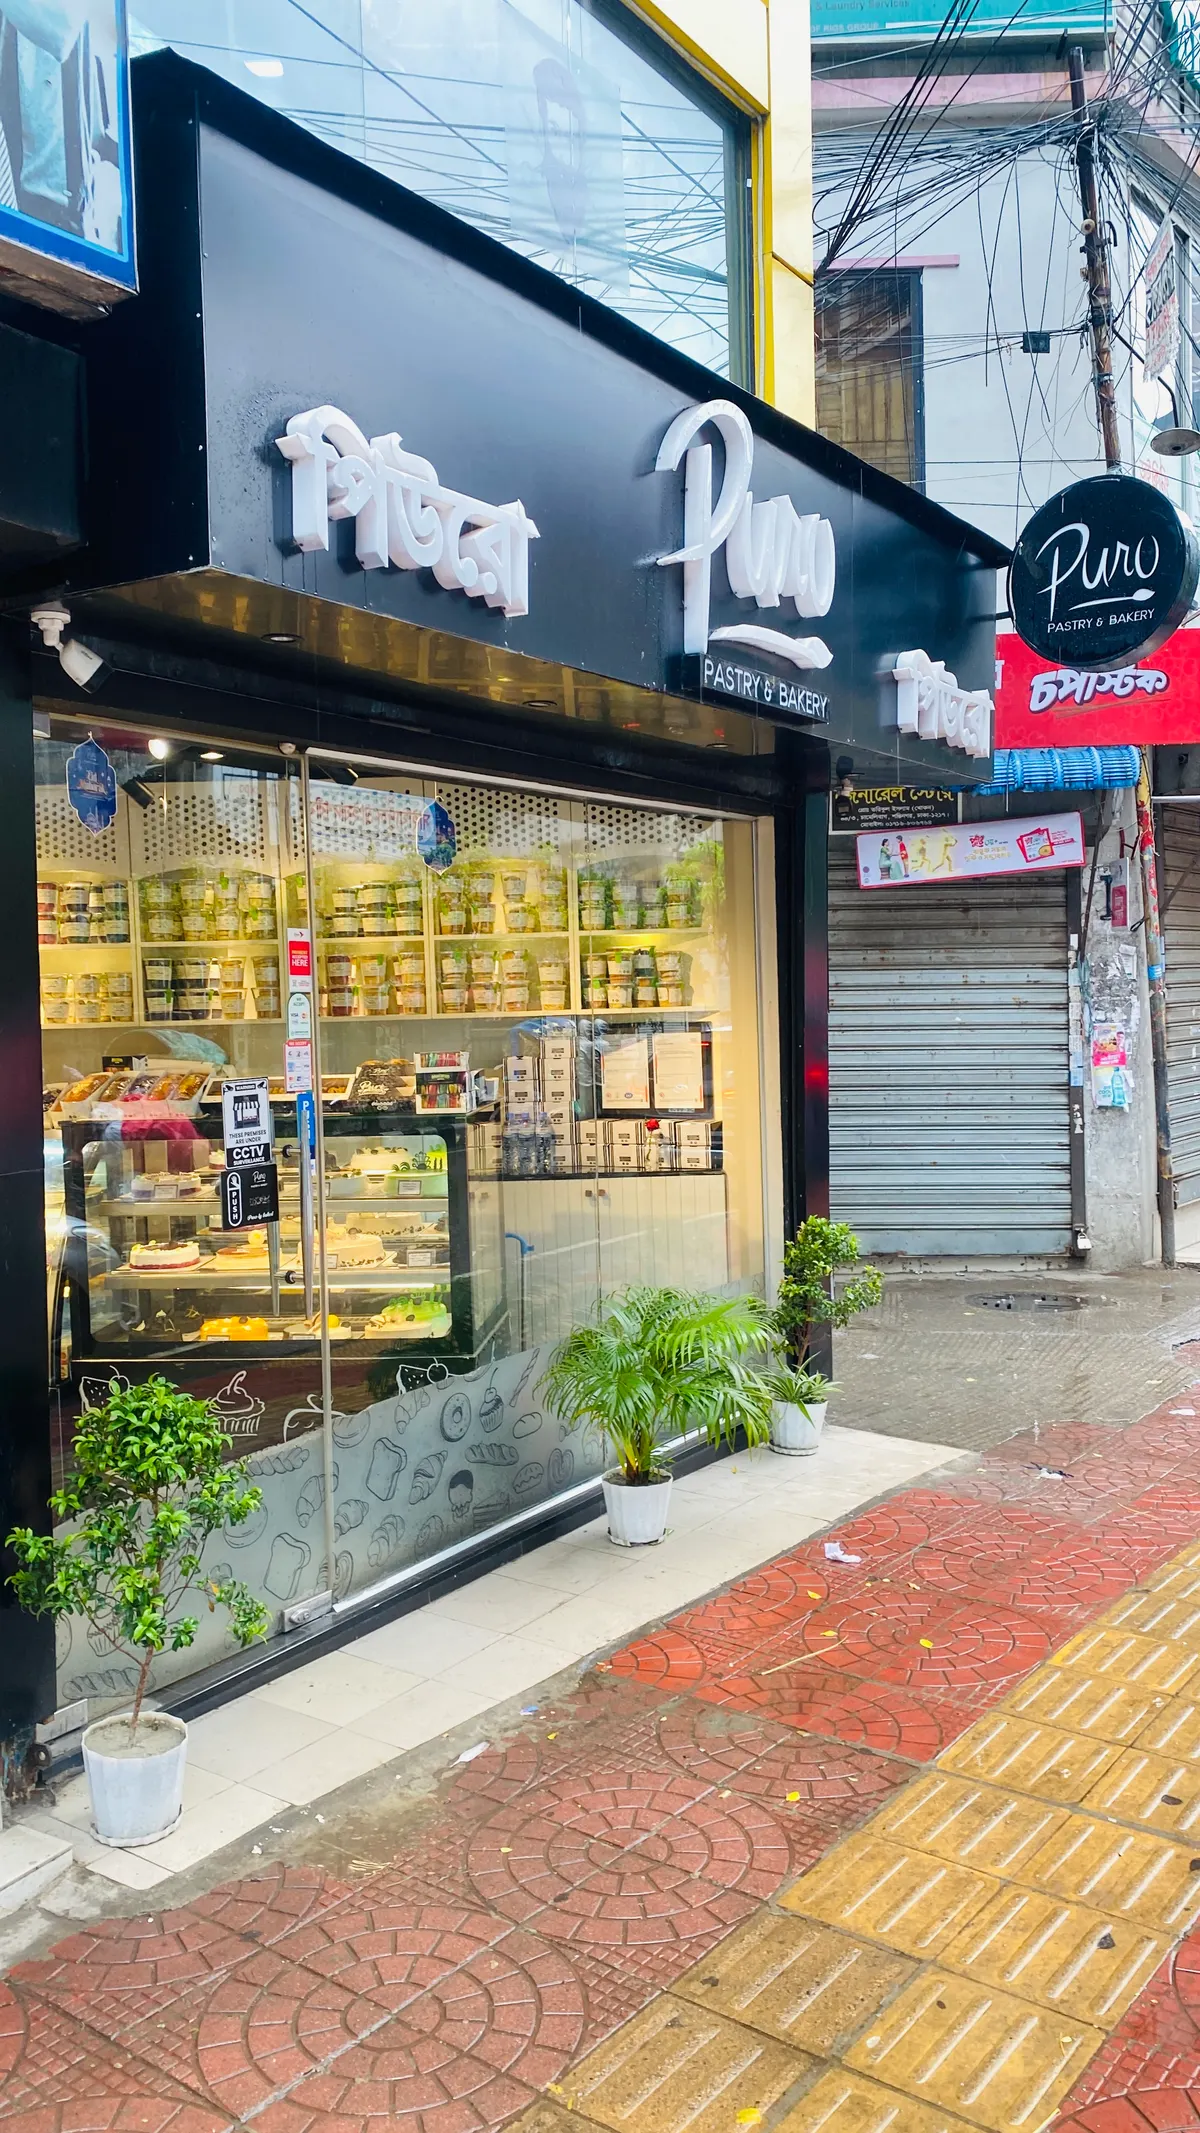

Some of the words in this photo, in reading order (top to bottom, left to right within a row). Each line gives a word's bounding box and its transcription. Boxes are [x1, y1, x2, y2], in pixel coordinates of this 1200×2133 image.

[825, 1, 864, 10] Laundry
[869, 0, 910, 8] Services
[275, 405, 541, 617] পিউরো
[655, 399, 836, 655] Puro
[1034, 522, 1160, 622] Puro
[1047, 618, 1093, 634] PASTRY
[1095, 617, 1103, 627] &
[1109, 608, 1155, 626] BAKERY
[703, 657, 762, 698] PASTRY
[763, 679, 773, 702] &
[778, 682, 829, 718] BAKERY
[892, 648, 996, 759] পিউরো
[291, 959, 309, 967] HERE
[232, 1145, 265, 1160] CCTV
[233, 1157, 265, 1166] SURVEILLANCE
